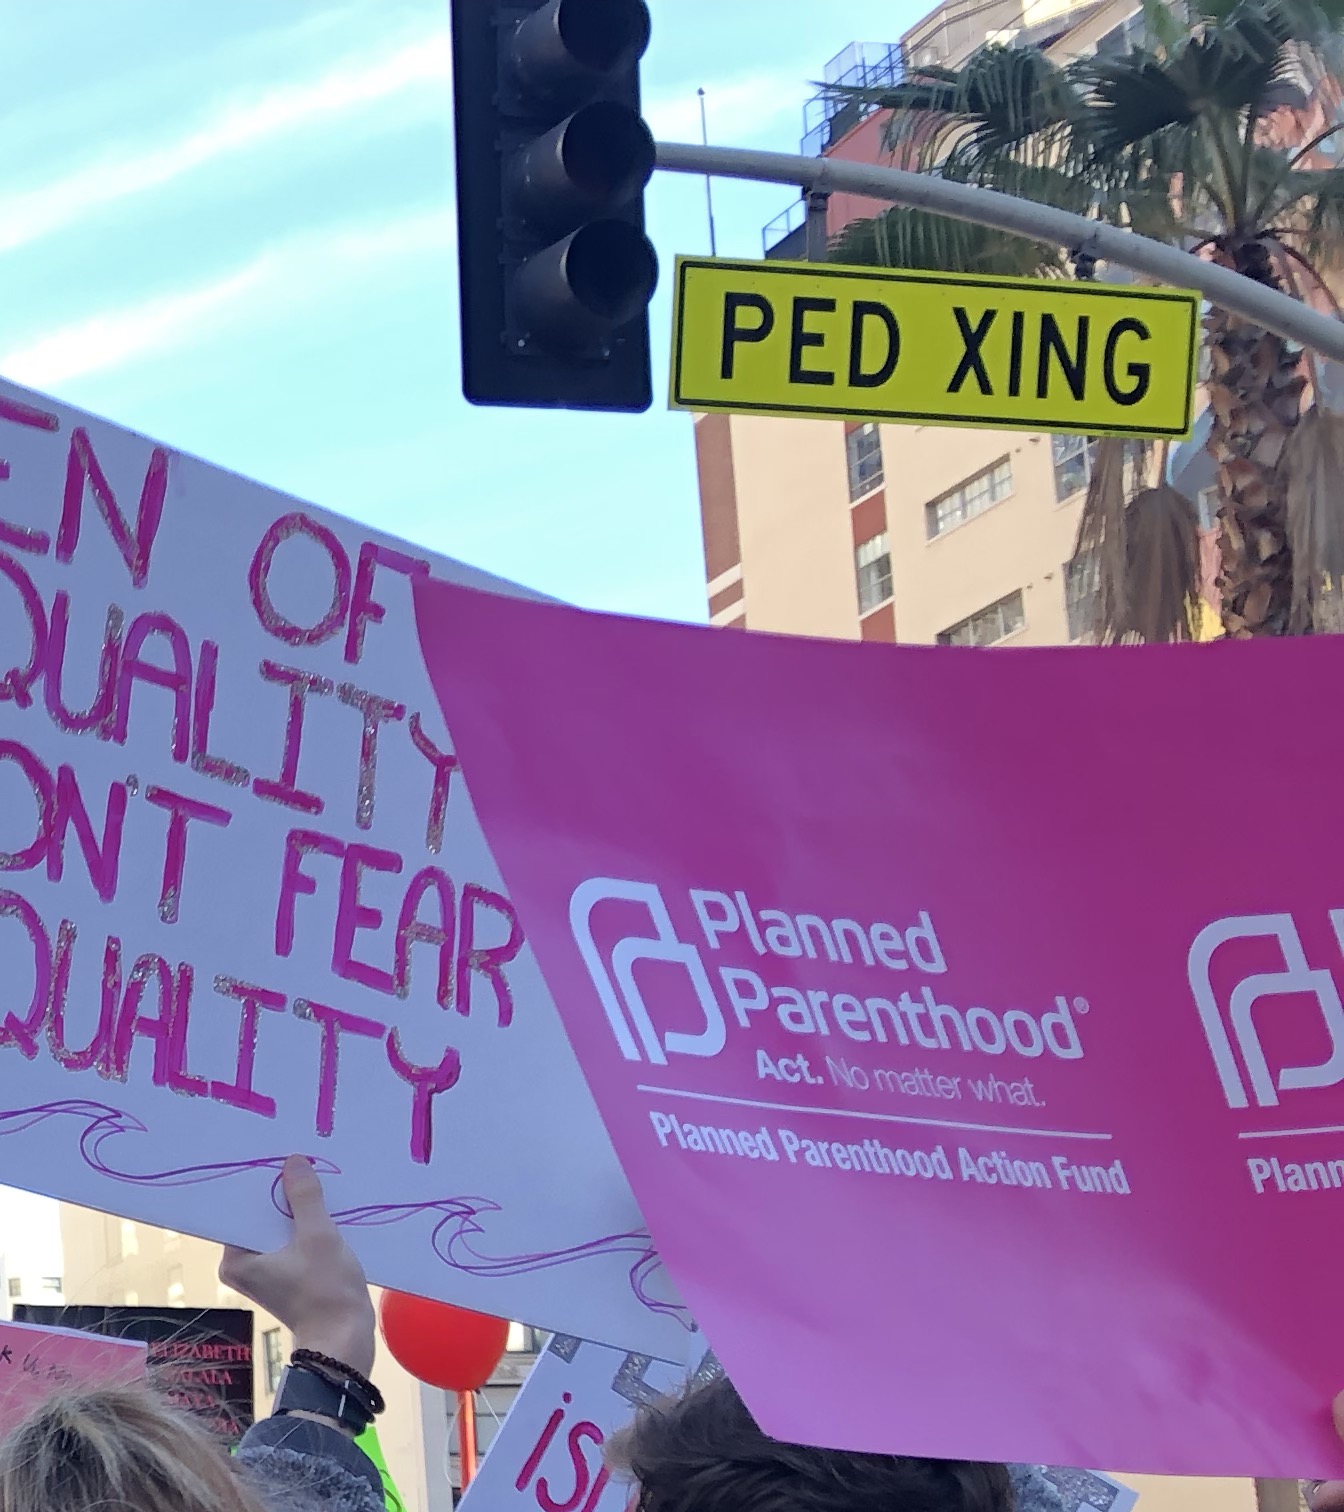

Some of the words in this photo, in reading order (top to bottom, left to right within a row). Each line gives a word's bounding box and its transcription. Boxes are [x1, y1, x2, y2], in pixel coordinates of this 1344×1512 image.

[720, 291, 901, 388] PED
[946, 305, 1152, 406] XING
[249, 511, 431, 664] OF
[275, 829, 525, 1027] FEAR
[689, 888, 949, 974] Planned
[755, 1048, 824, 1085] Act.
[825, 1055, 870, 1091] No
[873, 1067, 962, 1100] matter
[967, 1072, 1047, 1107] what.
[649, 1110, 779, 1162] Planned
[777, 1128, 954, 1181] Parenthood
[957, 1146, 1052, 1189] Action
[1050, 1155, 1131, 1194] Fund
